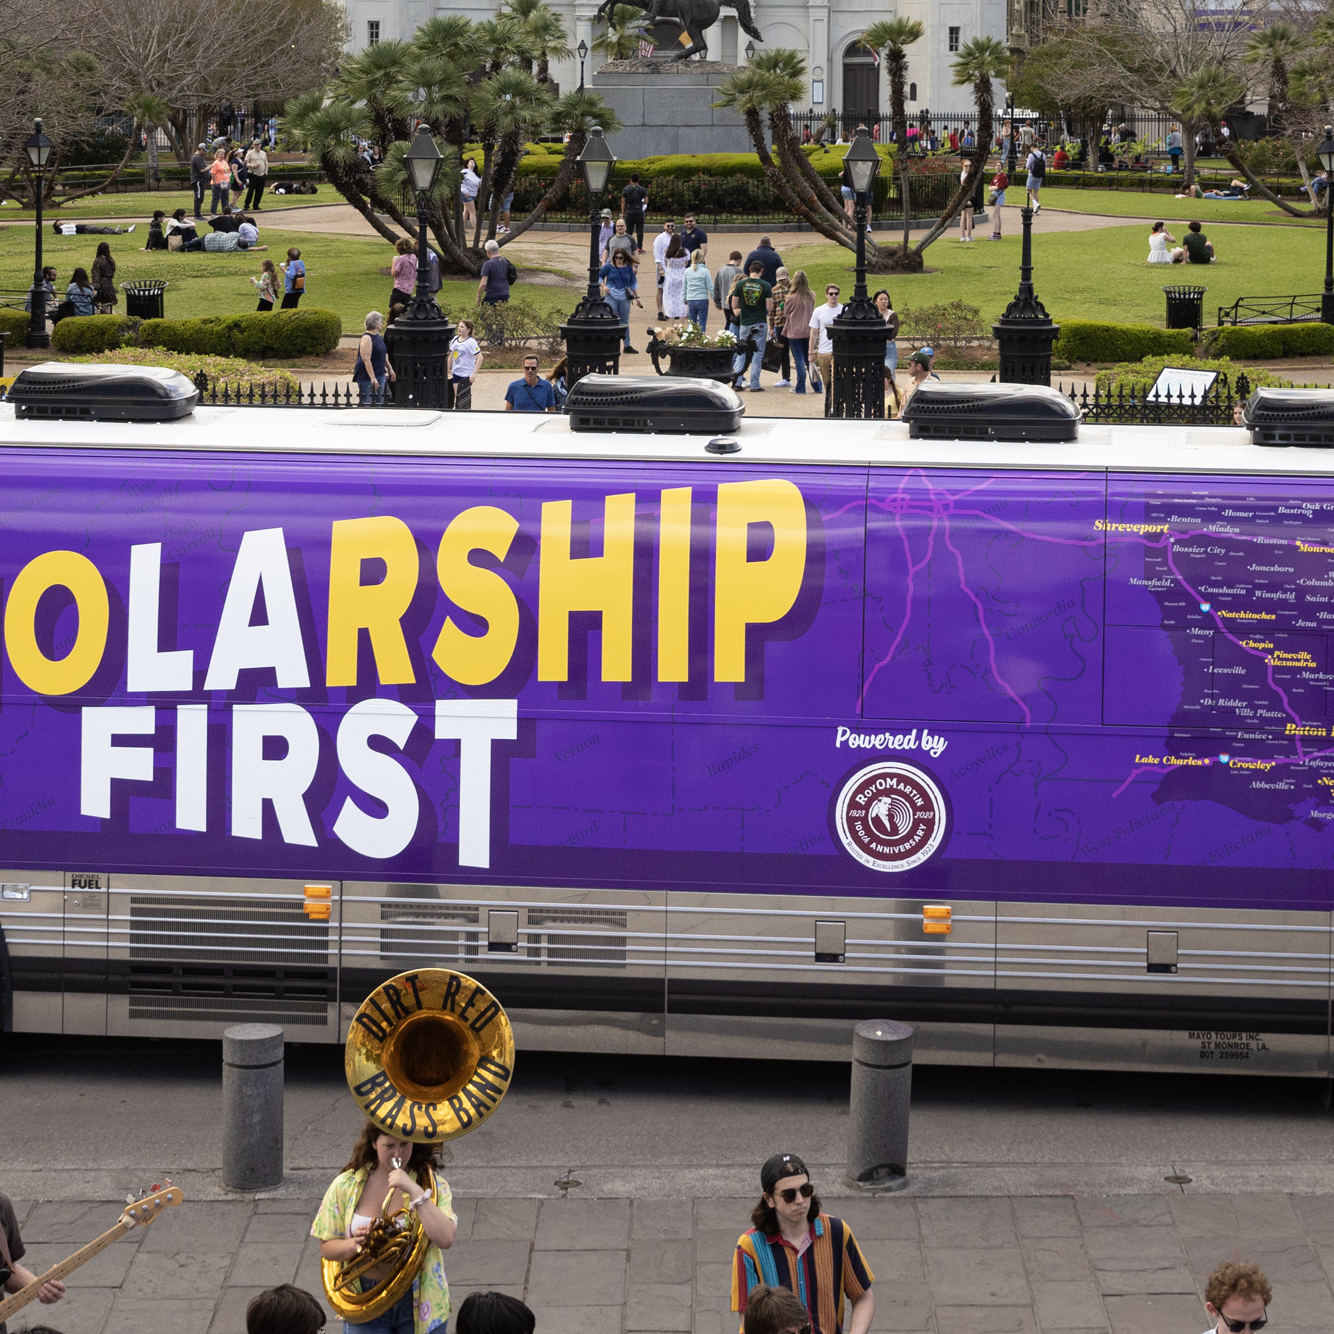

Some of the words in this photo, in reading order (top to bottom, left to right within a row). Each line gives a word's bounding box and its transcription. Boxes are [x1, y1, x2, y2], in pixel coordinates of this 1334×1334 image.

[1278, 507, 1313, 516] Bastrop
[1093, 519, 1169, 535] Shreveport
[1207, 525, 1240, 533] Minden
[1257, 537, 1287, 545] Ruston
[1173, 545, 1205, 553] Bossier
[1207, 546, 1225, 555] City
[1298, 544, 1334, 553] Monroe
[1249, 564, 1294, 572] Jonesboro
[1128, 578, 1170, 588] Mansfield
[1201, 586, 1246, 595] Coushatta
[1255, 590, 1295, 600] Winnfield
[1305, 595, 1328, 603] Saint
[1005, 597, 1076, 641] Concordia
[1220, 610, 1276, 620] Natchitoches
[1295, 620, 1317, 628] Jena
[1190, 628, 1214, 637] Many
[1242, 640, 1274, 649] Chopin
[1273, 651, 1311, 659] Pineville
[1268, 659, 1317, 667] Alexandria
[1208, 666, 1246, 674] Leesville
[1203, 698, 1215, 706] De
[1218, 698, 1248, 707] Ridder
[1235, 708, 1254, 716] Ville
[1257, 709, 1282, 717] Platte
[1284, 723, 1326, 736] Baton
[1237, 731, 1267, 739] Eunice
[835, 726, 919, 750] Powered
[921, 729, 948, 758] by
[1135, 755, 1160, 764] Lake
[1163, 756, 1202, 766] Charles
[1229, 760, 1272, 771] Crowley
[80, 698, 518, 869] FIRST
[849, 809, 865, 817] 1923
[854, 821, 871, 844] 100th
[869, 824, 927, 854] ANNIVERSARY
[921, 843, 934, 856] 1923
[71, 879, 101, 889] FUEL
[355, 974, 423, 1044] DIRT
[442, 975, 500, 1034] RED
[1188, 1032, 1212, 1040] MAYO
[1246, 1033, 1263, 1041] INC.
[1215, 1042, 1253, 1051] MONROE,
[1257, 1043, 1269, 1051] LA.
[1200, 1051, 1214, 1059] DOT
[1219, 1052, 1249, 1060] 259954
[353, 1070, 437, 1137] BRASS
[447, 1055, 511, 1130] BAND
